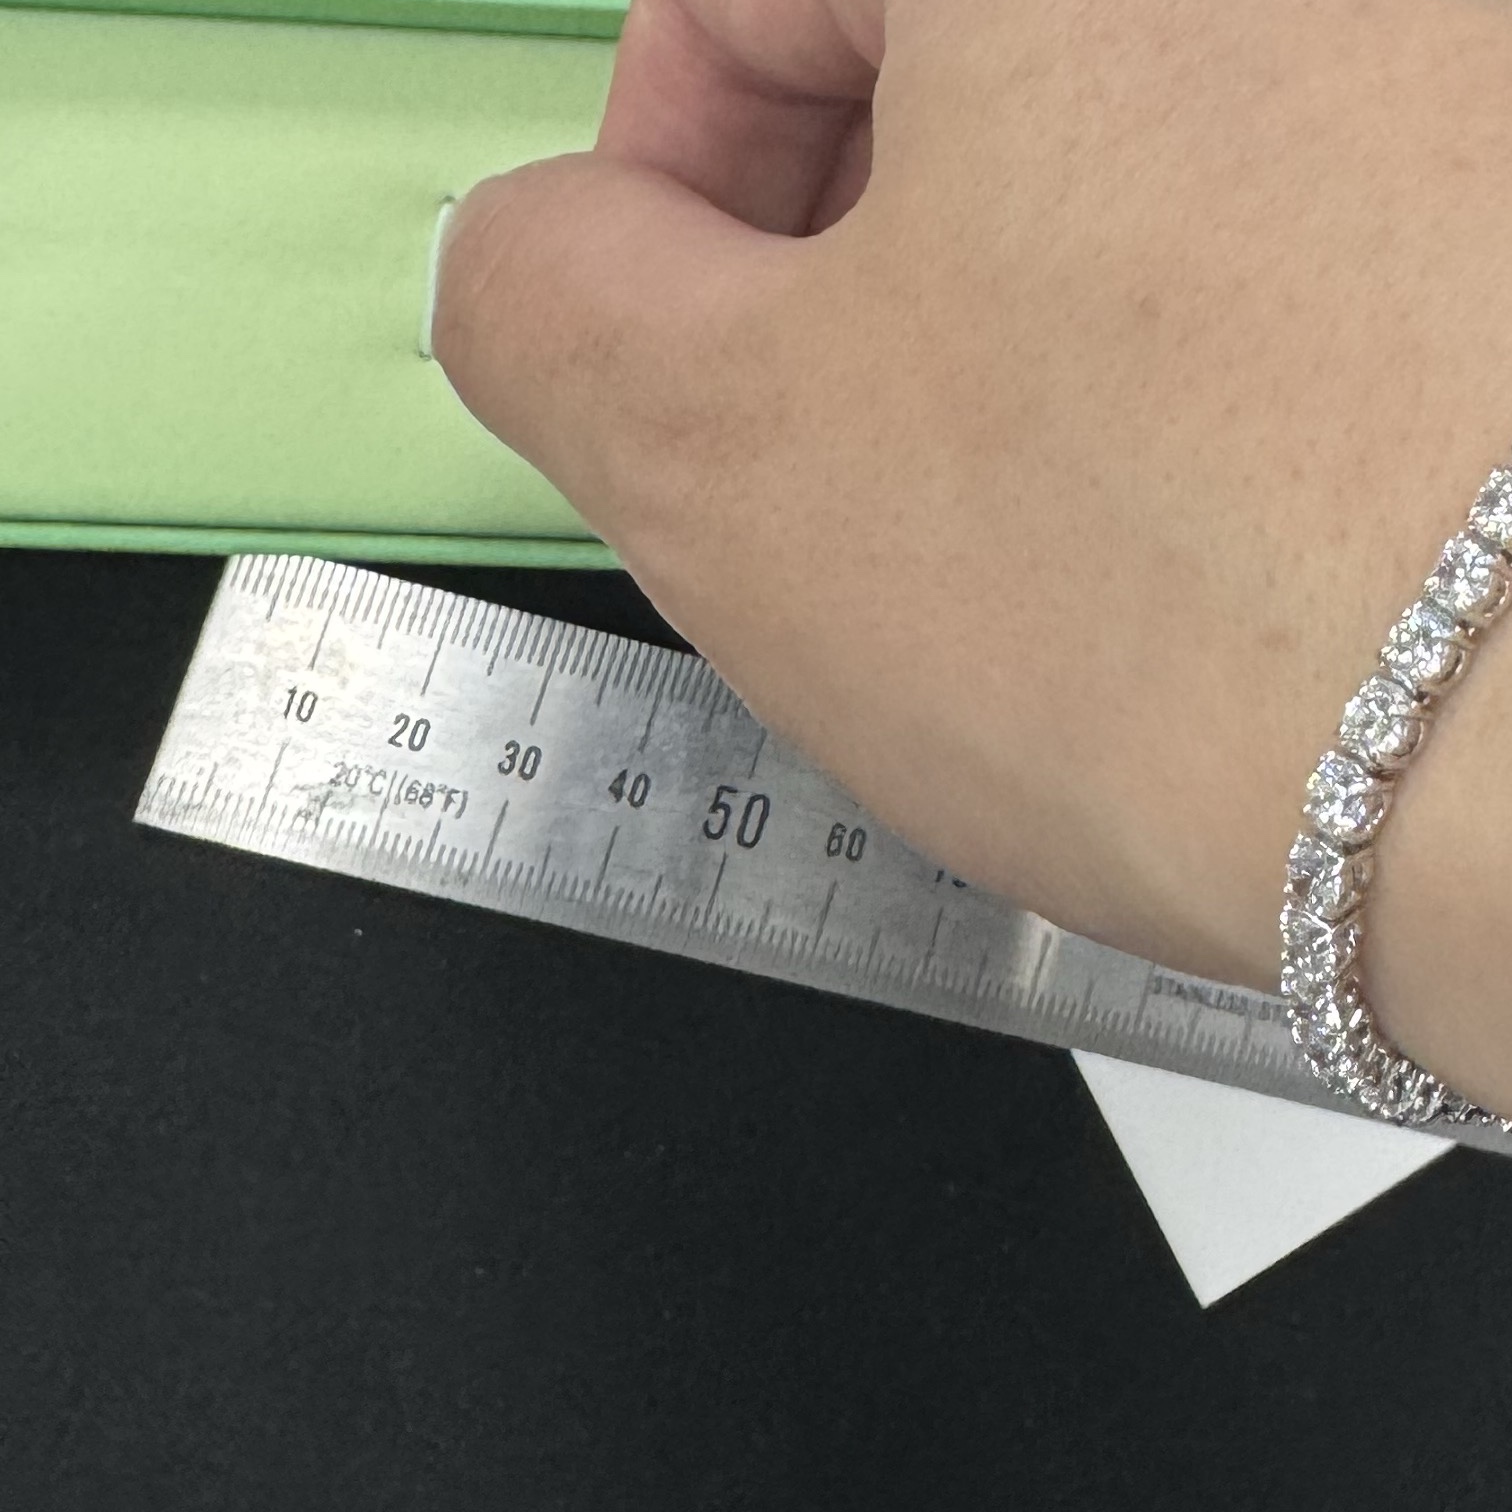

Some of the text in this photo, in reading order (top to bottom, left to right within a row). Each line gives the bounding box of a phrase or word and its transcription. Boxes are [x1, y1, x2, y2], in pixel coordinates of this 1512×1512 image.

[283, 685, 867, 863] 10 20 30 40 50 60
